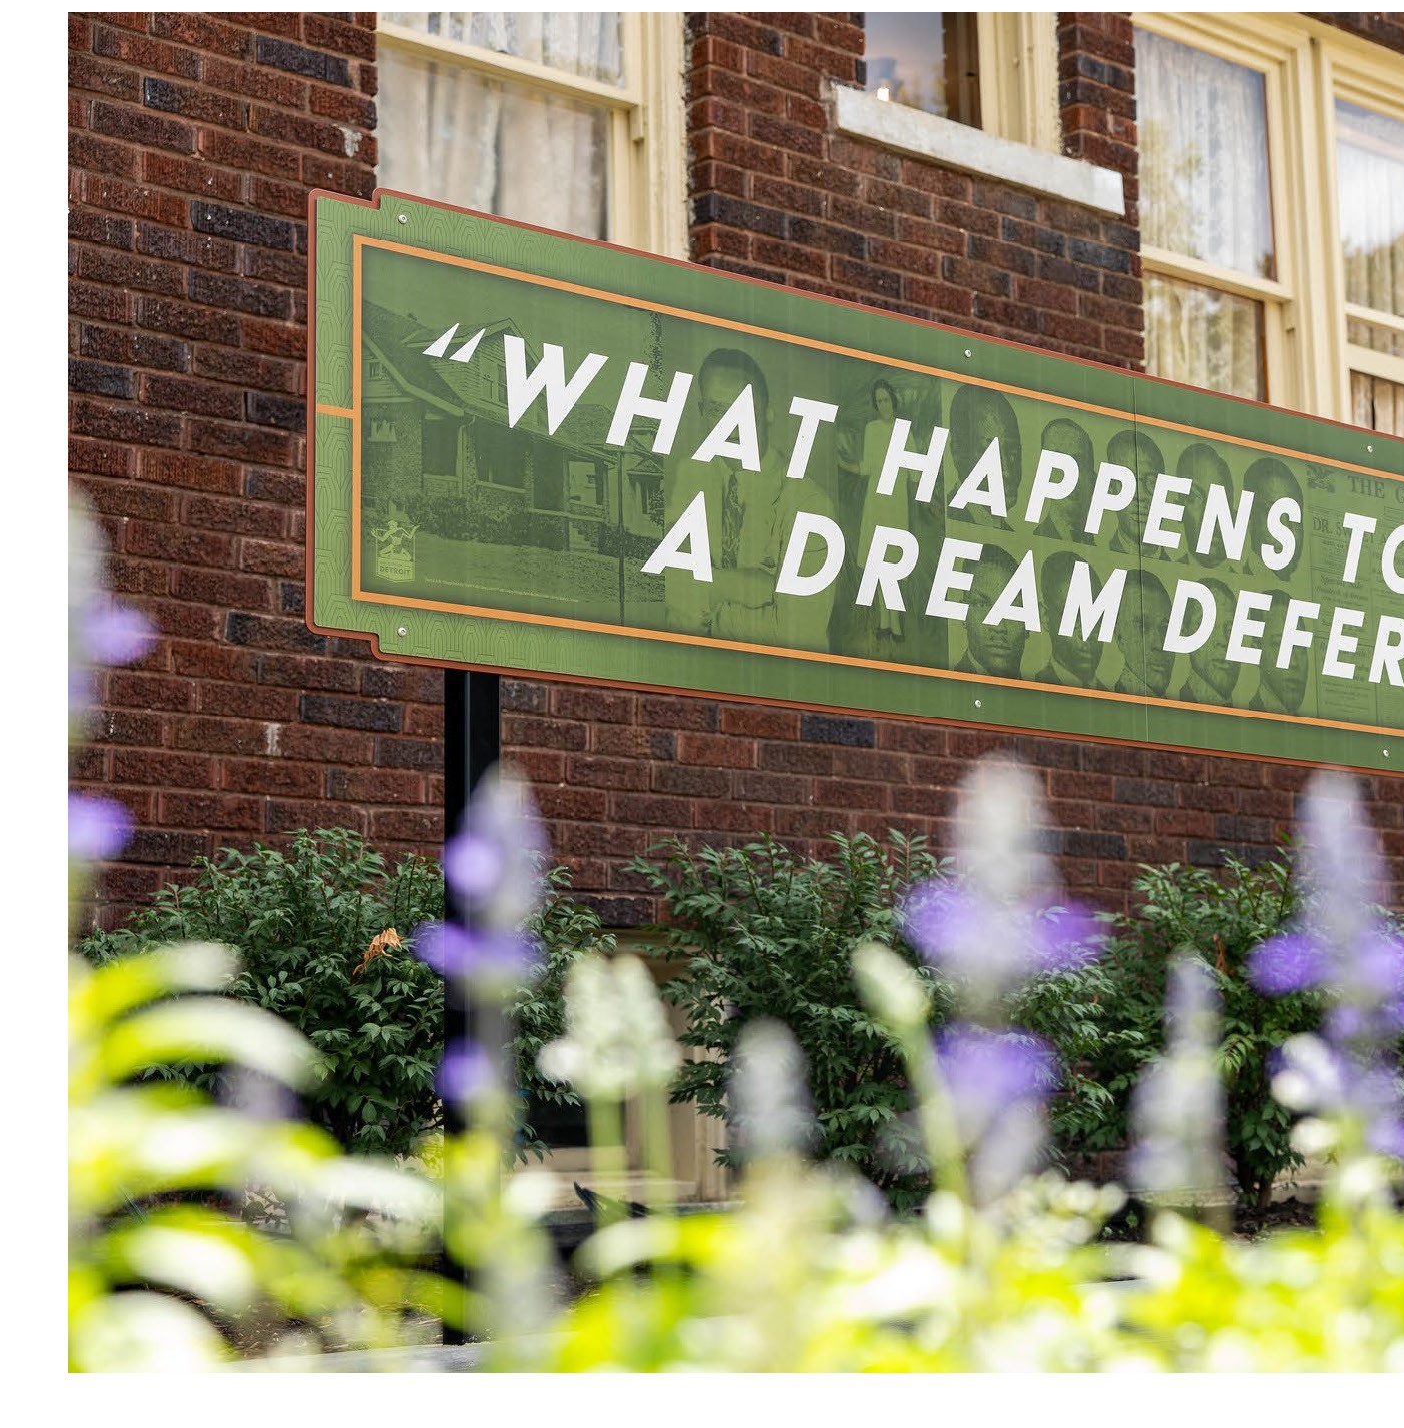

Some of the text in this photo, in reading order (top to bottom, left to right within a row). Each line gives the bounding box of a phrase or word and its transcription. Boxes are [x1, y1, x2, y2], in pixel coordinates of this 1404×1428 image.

[877, 419, 1302, 571] HAPPENS
[1347, 475, 1385, 499] THE
[641, 490, 713, 583] A
[776, 511, 1128, 643] DREAM
